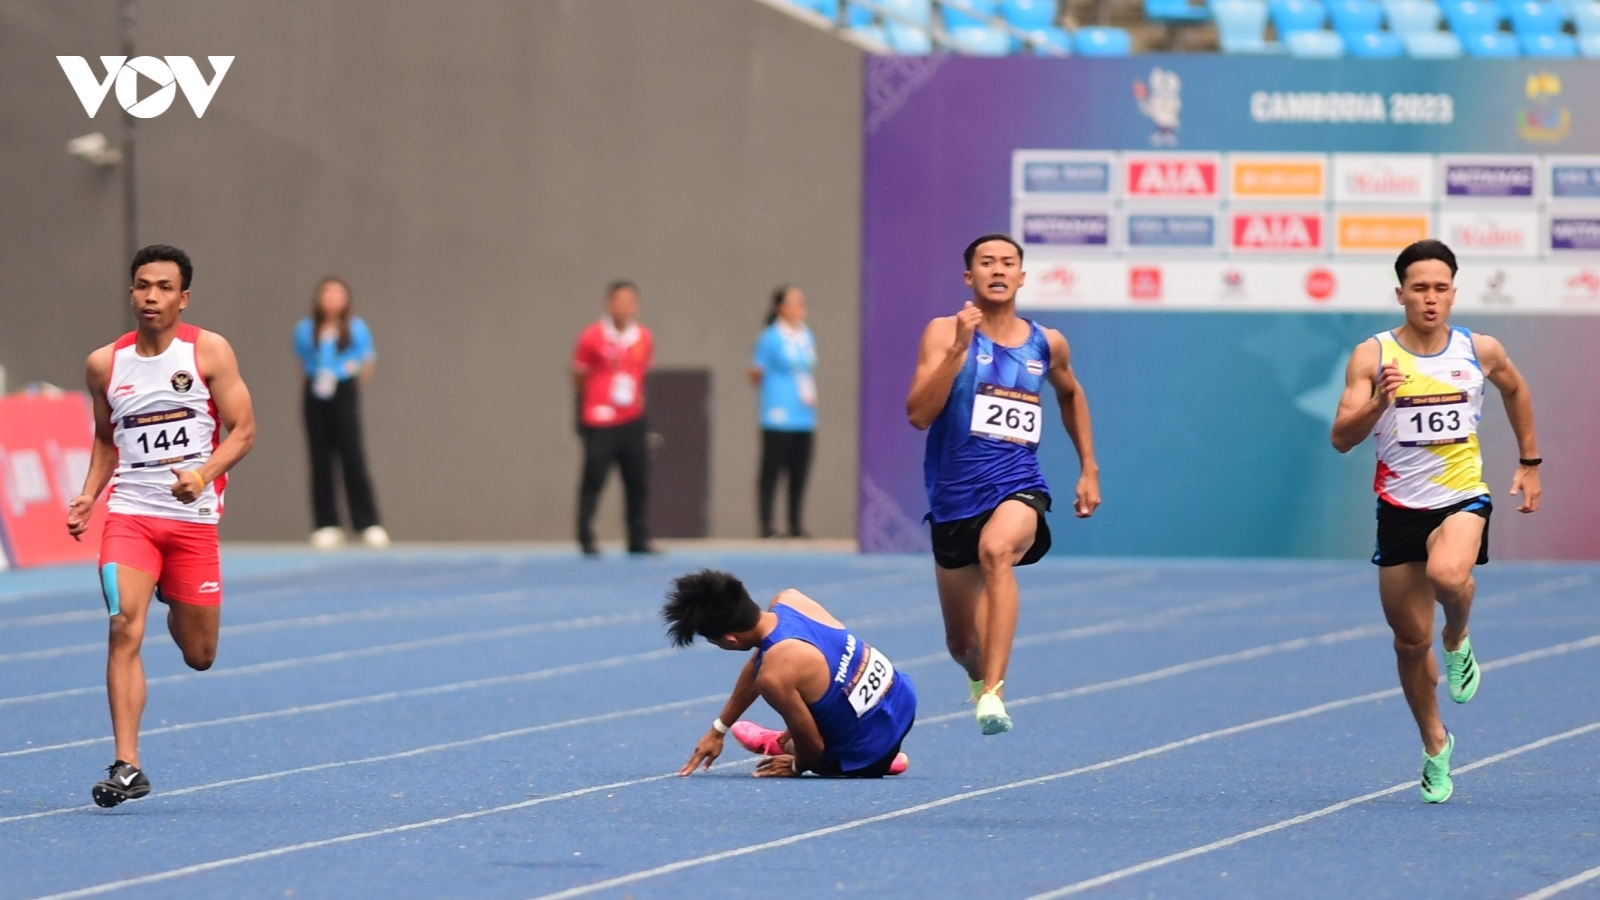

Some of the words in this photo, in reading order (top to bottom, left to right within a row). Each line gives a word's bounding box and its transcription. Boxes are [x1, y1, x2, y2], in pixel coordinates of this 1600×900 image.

[1251, 91, 1386, 123] CAMBODIA
[1389, 92, 1454, 123] 2023
[1136, 163, 1208, 193] AIA
[1241, 215, 1313, 247] AIA
[985, 404, 1036, 432] 263
[1410, 410, 1461, 433] 163
[136, 426, 190, 454] 144
[834, 634, 856, 683] THAILAND
[859, 660, 887, 706] 289
